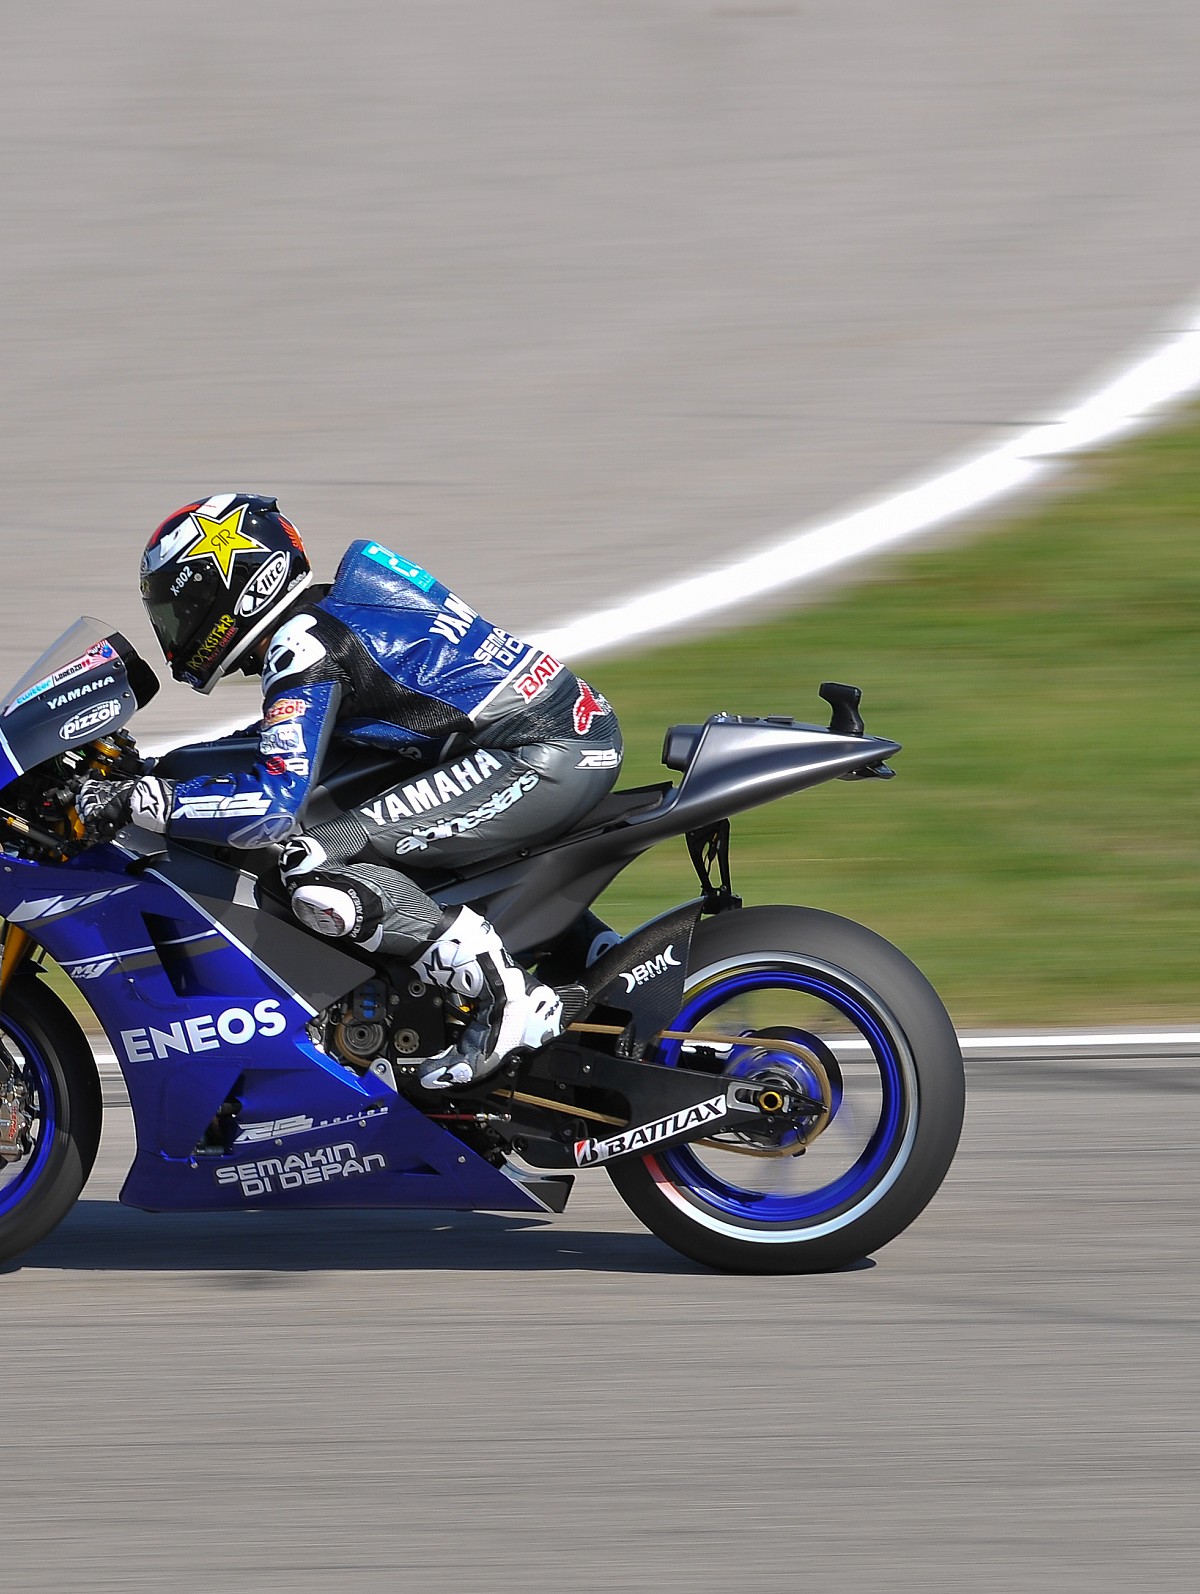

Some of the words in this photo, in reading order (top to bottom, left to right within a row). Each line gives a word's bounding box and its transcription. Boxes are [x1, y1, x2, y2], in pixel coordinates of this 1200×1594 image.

[242, 559, 284, 614] X-lite
[46, 675, 115, 710] YAMAHA
[63, 699, 120, 740] pizzoli
[360, 748, 503, 826] YAMAHA
[395, 769, 540, 855] alpinestars
[120, 998, 287, 1063] ENEOS
[605, 1098, 722, 1156] BATTLAX
[216, 1143, 356, 1184] SEMAKIN
[241, 1177, 272, 1197] DI
[279, 1154, 386, 1189] DEPAN
